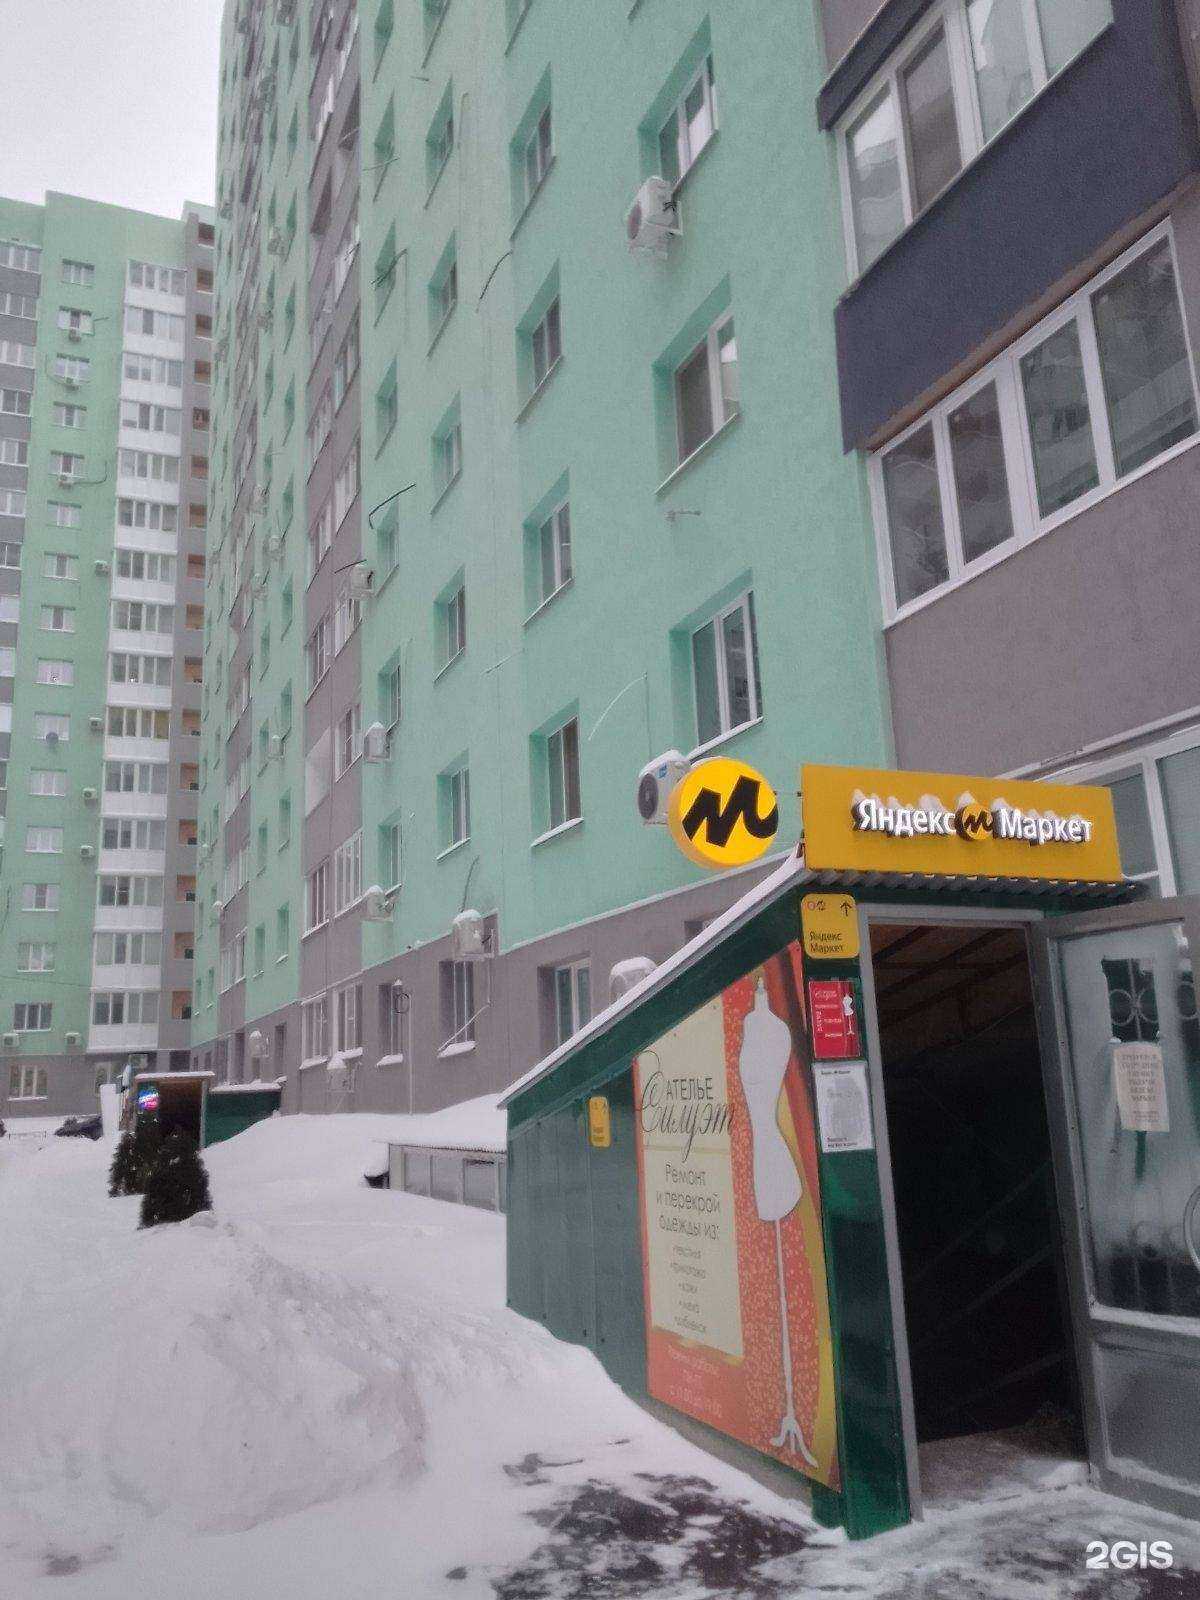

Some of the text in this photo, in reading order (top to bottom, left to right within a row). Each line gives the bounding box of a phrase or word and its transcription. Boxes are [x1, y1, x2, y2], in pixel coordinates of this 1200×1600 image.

[857, 798, 957, 838] Яндекс
[999, 807, 1094, 845] Маркет
[665, 1077, 714, 1101] АТЕЛЬЕ
[665, 1163, 706, 1187] Ремонт
[656, 1190, 720, 1214] и перекрой
[659, 1214, 702, 1238] одежды
